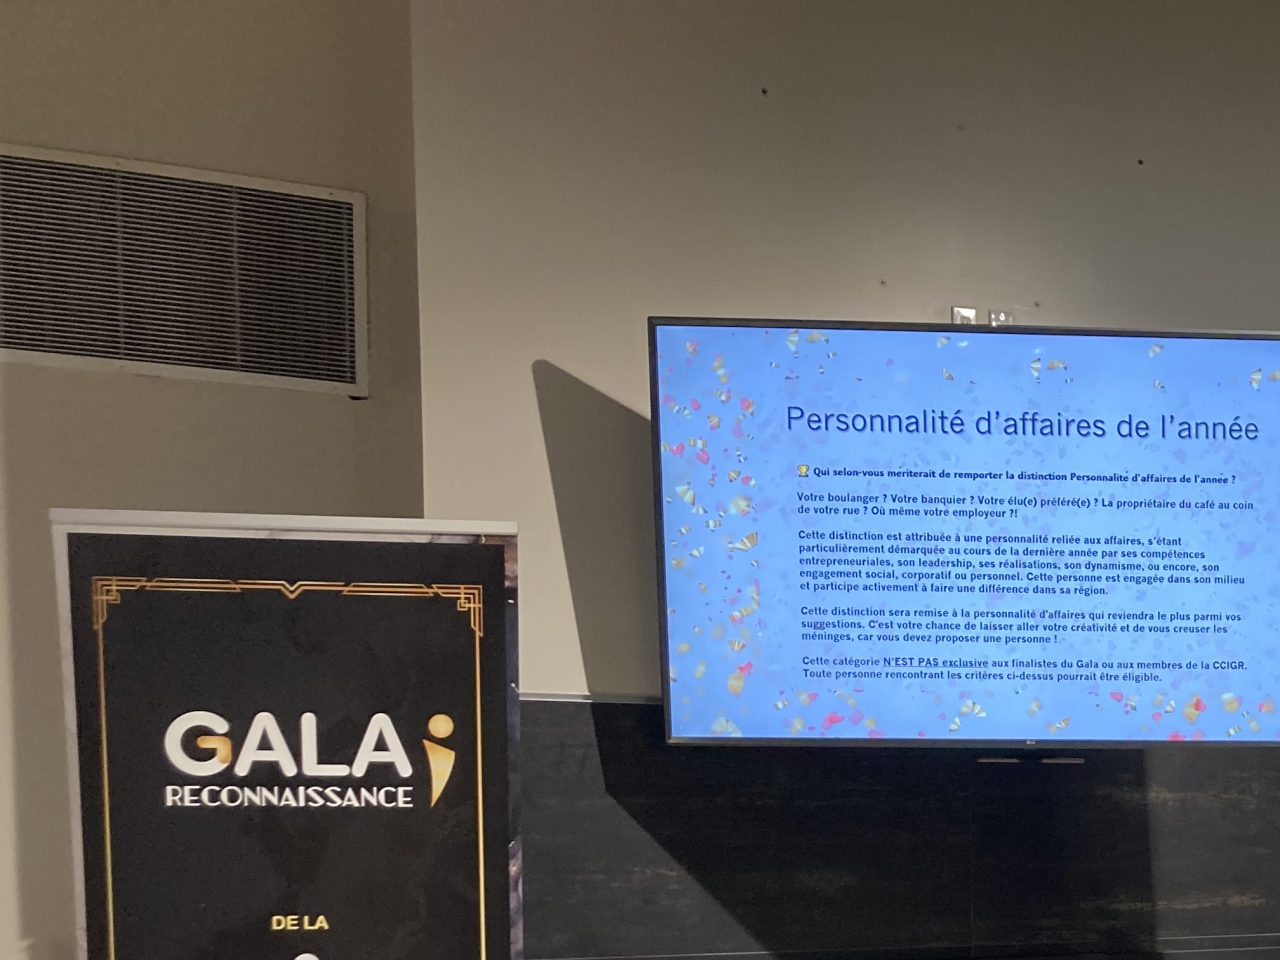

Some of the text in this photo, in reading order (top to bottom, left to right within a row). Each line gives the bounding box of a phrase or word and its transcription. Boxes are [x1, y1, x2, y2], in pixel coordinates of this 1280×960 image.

[787, 406, 1258, 440] Personnalité d'affaires de l'année
[798, 530, 825, 539] Cette
[828, 530, 883, 540] distinction
[886, 532, 902, 540] est
[905, 532, 951, 541] attribuée
[954, 533, 960, 542] à
[985, 533, 1048, 545] personnalité
[1052, 534, 1080, 544] reliée
[1104, 535, 1144, 546] affaires,
[1147, 536, 1181, 545] s'étant
[799, 543, 884, 555] particulièrement
[887, 544, 945, 556] démarquée
[963, 547, 991, 555] cours
[994, 546, 1007, 555] de
[1010, 546, 1019, 555] la
[1022, 547, 1065, 556] dernière
[1068, 547, 1098, 557] année
[1101, 550, 1117, 559] par
[1140, 549, 1205, 560] compétences
[799, 556, 893, 568] entrepreneuriales,
[918, 558, 975, 569] leadership,
[998, 559, 1060, 569] réalisations,
[1084, 560, 1144, 572] dynamisme,
[1162, 564, 1199, 572] encore,
[800, 606, 828, 615] Cette
[831, 606, 885, 616] distinction
[913, 608, 948, 617] remise
[951, 608, 957, 617] à
[961, 608, 970, 617] la
[973, 609, 1035, 620] personnalité
[1039, 609, 1085, 619] d'affaires
[1088, 610, 1104, 621] qui
[1107, 611, 1154, 620] reviendra
[1157, 611, 1166, 620] le
[1170, 611, 1190, 622] plus
[1193, 612, 1221, 622] parmi
[802, 656, 829, 665] Cette
[832, 656, 880, 667] catégorie
[883, 657, 914, 666] N'EST
[918, 657, 938, 666] PAS
[942, 658, 988, 667] exclusive
[1011, 658, 1057, 668] finalistes
[1060, 659, 1072, 668] du
[1076, 659, 1098, 668] Gala
[1136, 660, 1182, 669] membres
[1185, 660, 1197, 669] de
[1201, 661, 1209, 669] la
[1212, 660, 1248, 669] CCIGR.
[164, 710, 412, 778] GALA
[165, 786, 413, 808] RECONNAISSANCE
[271, 914, 329, 931] DE LA
